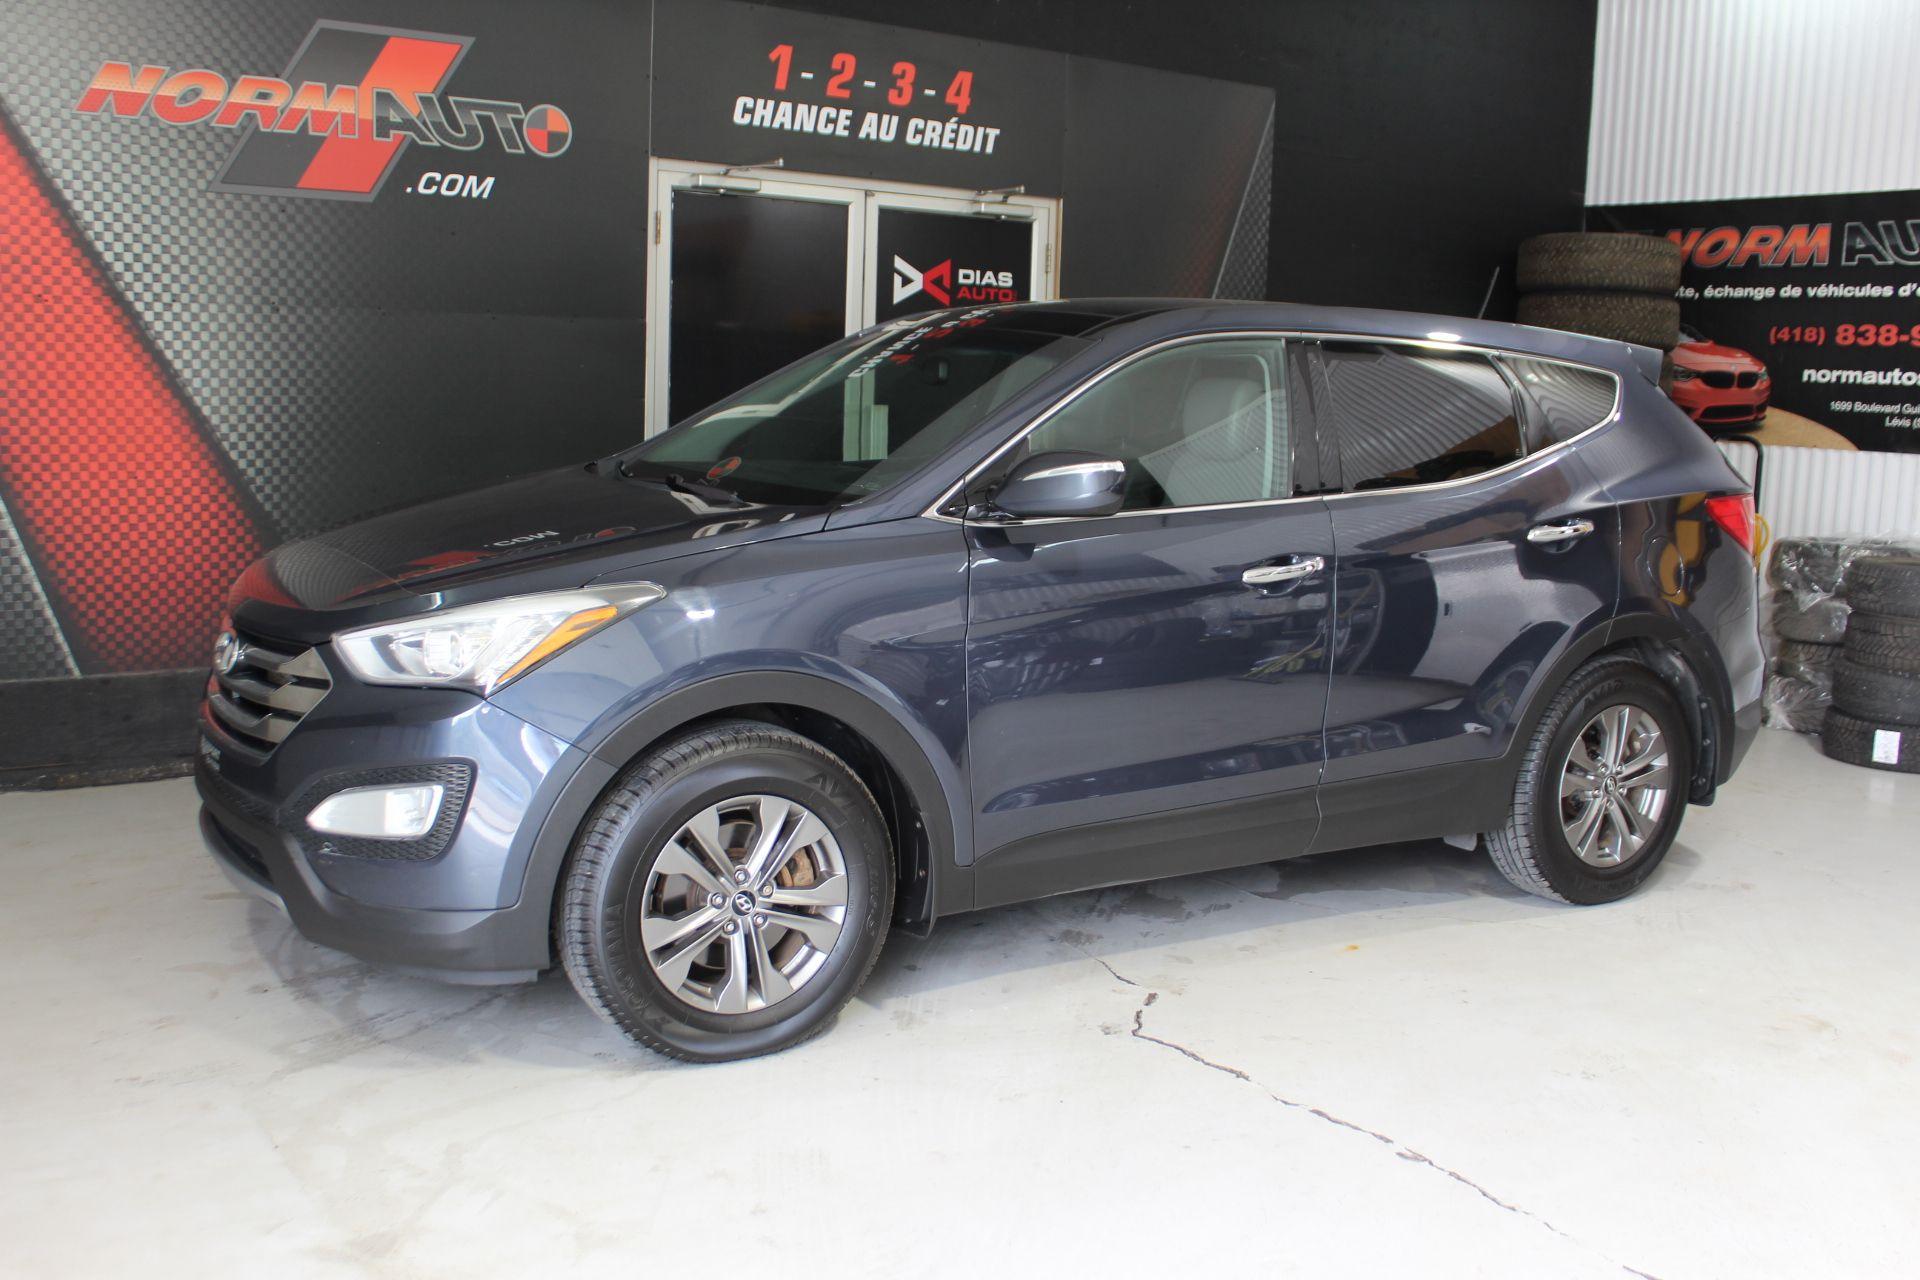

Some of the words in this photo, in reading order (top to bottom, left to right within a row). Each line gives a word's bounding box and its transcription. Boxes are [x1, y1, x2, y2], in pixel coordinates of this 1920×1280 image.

[732, 96, 853, 137] CHANCE
[858, 111, 899, 142] AU
[905, 116, 1000, 154] CRÉDIT
[406, 171, 495, 199] .COM
[1665, 223, 1832, 268] NORM
[958, 268, 1013, 287] DIAS
[957, 287, 1013, 302] AUTO
[1675, 285, 1699, 300] te,
[1703, 284, 1776, 301] échange
[1780, 284, 1802, 299] de
[1806, 283, 1894, 298] véhicules
[1769, 326, 1826, 346] (418)
[1801, 367, 1920, 387] normauto
[1830, 401, 1853, 412] 1699
[1853, 402, 1901, 414] Boulevard
[1885, 415, 1912, 428] Lévis
